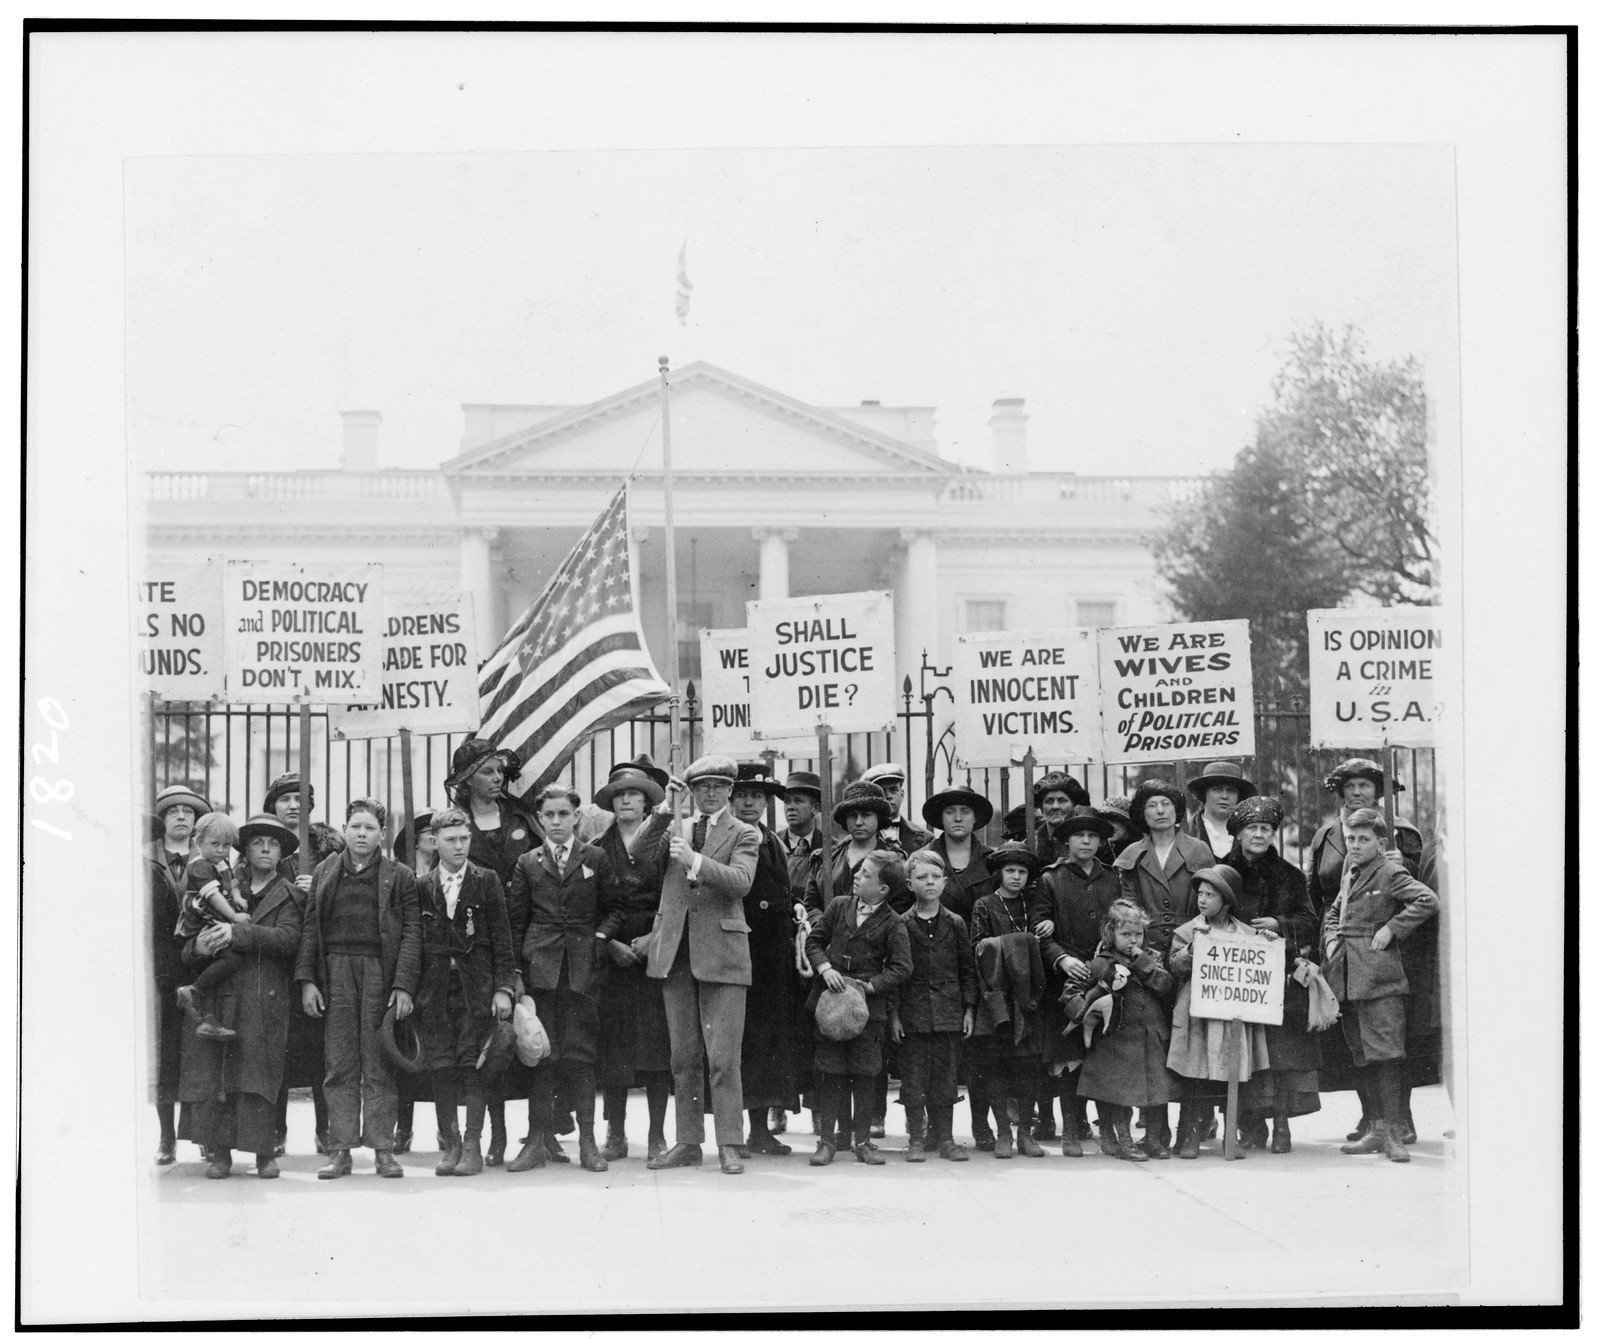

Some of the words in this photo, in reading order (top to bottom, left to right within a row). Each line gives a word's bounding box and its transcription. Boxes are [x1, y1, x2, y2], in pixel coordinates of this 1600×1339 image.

[242, 580, 368, 602] DEMOCRACY
[171, 613, 205, 637] NO
[238, 611, 264, 633] and
[271, 609, 363, 634] POLITICAL
[383, 613, 460, 637] DRENS
[775, 617, 857, 645] SHALL
[1324, 630, 1342, 651] IS
[1350, 629, 1442, 651] OPINION
[138, 648, 208, 676] UNDS.
[256, 641, 361, 663] PRISONERS
[382, 646, 423, 671] ADE
[430, 643, 467, 668] FOR
[720, 648, 749, 669] WE
[765, 646, 874, 678] JUSTICE
[979, 650, 1012, 668] WE
[1020, 648, 1065, 666] ARE
[1114, 653, 1232, 677] WIVES
[1336, 661, 1351, 680] A
[1360, 660, 1433, 680] CRIME
[242, 667, 302, 688] DON'T
[315, 670, 361, 689] MIX.
[970, 675, 1079, 703] INNOCENT
[1155, 677, 1193, 687] AND
[1369, 683, 1392, 695] in
[983, 710, 1078, 735] VICTIMS.
[1117, 712, 1138, 735] of
[29, 696, 75, 841] 1820
[1207, 945, 1219, 961] 4
[1223, 946, 1266, 965] YEARS
[1200, 964, 1234, 982] SINCE
[1238, 967, 1242, 983] I
[1245, 968, 1272, 985] SAW
[1201, 984, 1218, 999] MY
[1224, 986, 1268, 1005] DADDY.
